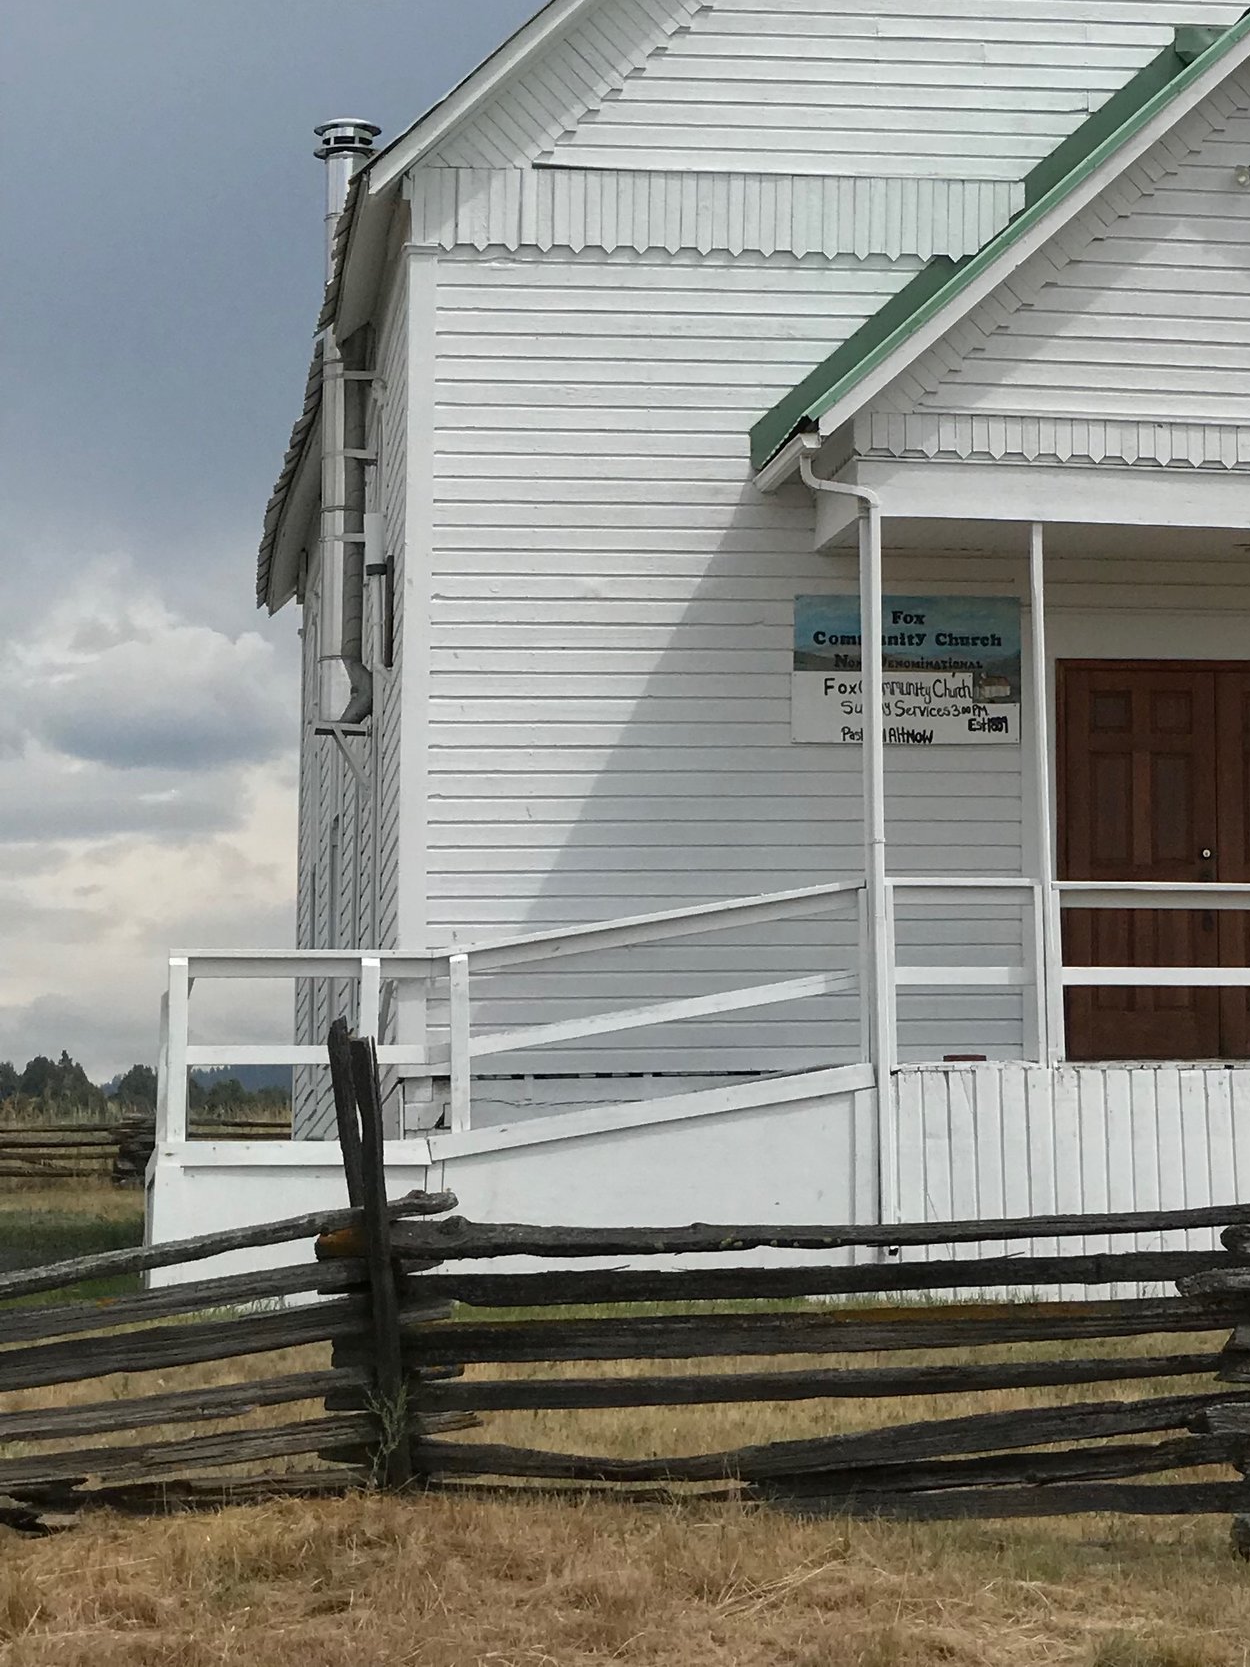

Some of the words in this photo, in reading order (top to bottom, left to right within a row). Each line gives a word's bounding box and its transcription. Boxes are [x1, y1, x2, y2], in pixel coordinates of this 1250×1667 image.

[891, 610, 926, 625] Fox
[813, 630, 927, 647] Comnity
[935, 632, 1002, 647] Church
[823, 677, 857, 696] Fox
[841, 700, 892, 717] Suy
[894, 700, 951, 717] Services
